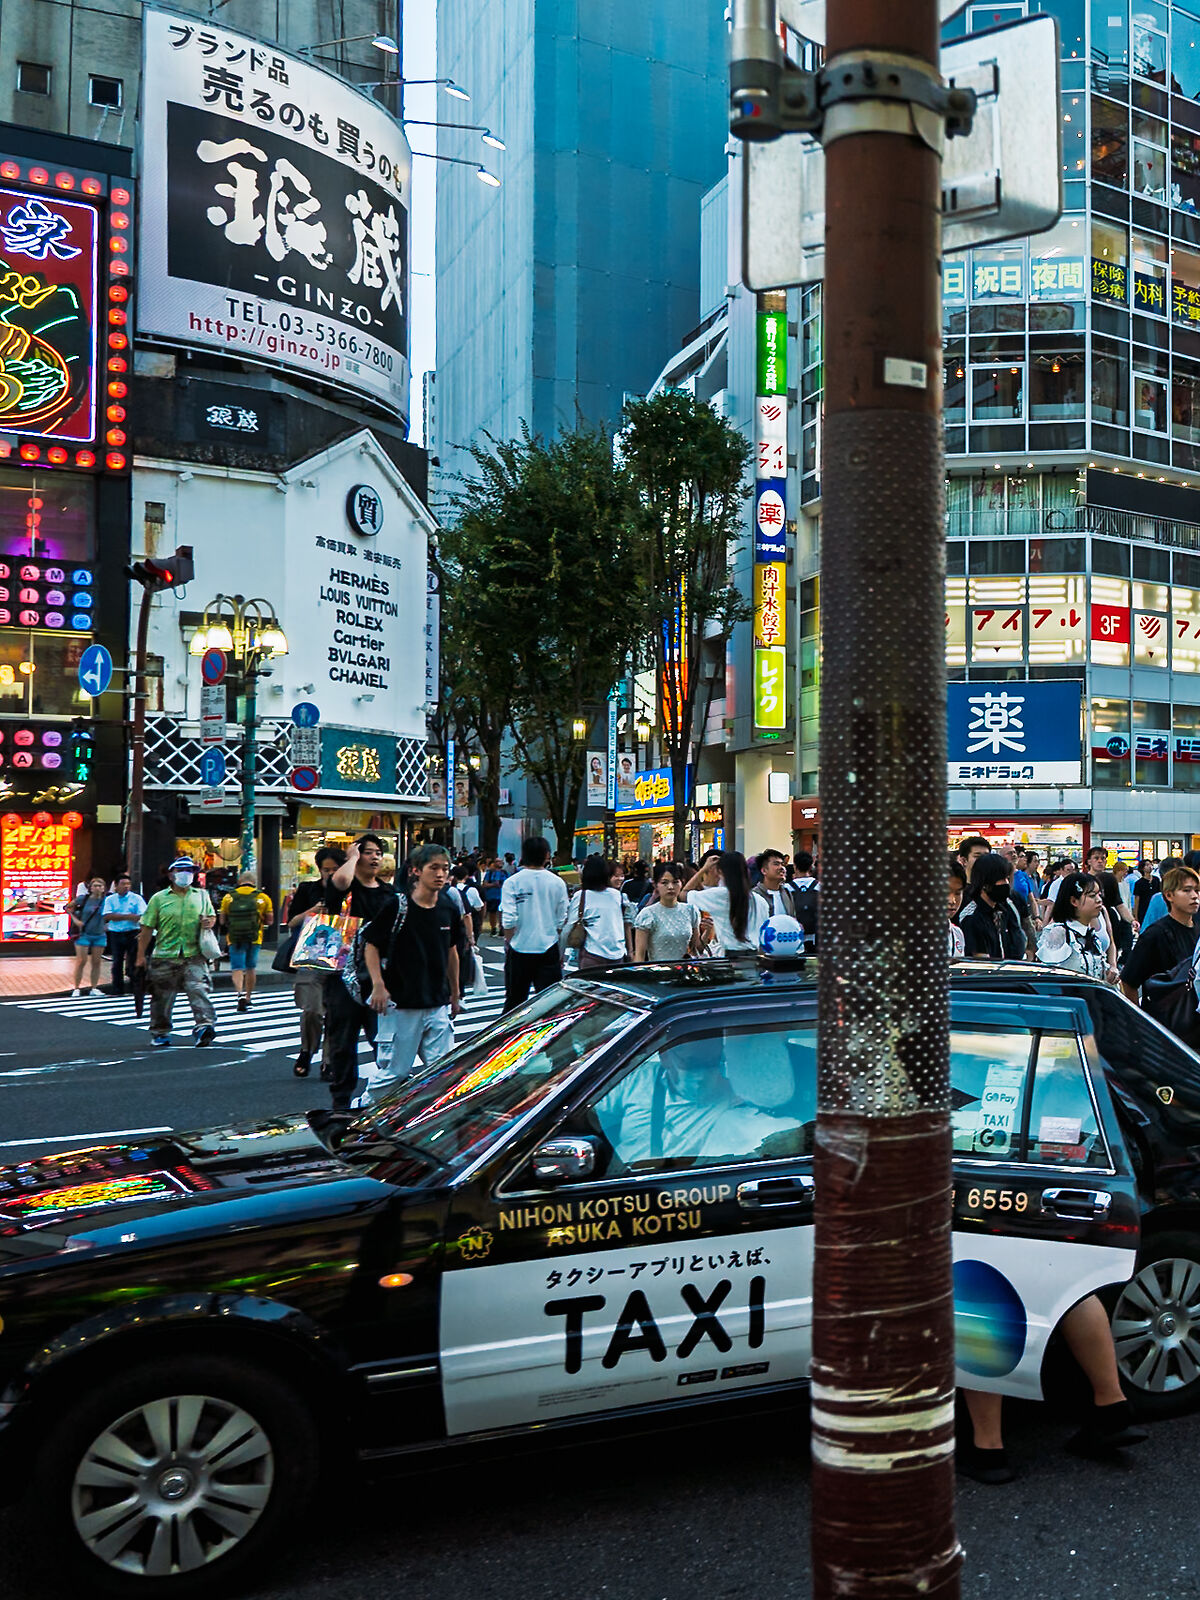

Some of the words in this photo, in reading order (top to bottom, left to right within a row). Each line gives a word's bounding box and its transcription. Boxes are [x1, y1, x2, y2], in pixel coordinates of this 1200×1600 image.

[169, 24, 290, 86] ブランド品
[197, 138, 403, 315] 銀蔵
[945, 268, 964, 292] 日
[975, 266, 1022, 292] 祝日
[1033, 262, 1083, 289] 夜間
[1093, 262, 1125, 283] 保険
[1093, 279, 1125, 300] 診療
[1135, 282, 1164, 307] 内科
[189, 313, 341, 369] http://ginzo.jp
[226, 298, 393, 372] TEL.03-5366-7800
[359, 493, 377, 530] 質
[760, 503, 781, 524] 薬
[315, 535, 357, 556] 高価買取
[329, 568, 390, 595] HERMÈS
[320, 586, 350, 605] LOUIS
[356, 594, 398, 617] VUITTON
[763, 567, 779, 643] 肉汁水餃子
[337, 609, 384, 632] ROLEX
[975, 609, 1081, 631] アイフル
[1100, 616, 1120, 635] 3F
[334, 630, 385, 651] Cartier
[328, 648, 390, 671] BVLGARI
[329, 667, 388, 689] CHANEL
[761, 660, 778, 712] レイク
[966, 692, 1026, 754] 薬
[206, 760, 215, 782] P
[959, 766, 1034, 780] ミネドラッグ
[4, 826, 70, 842] 2F/3F
[985, 1092, 998, 1102] GO
[1000, 1093, 1016, 1104] Pay
[983, 1114, 1009, 1127] TAXI
[499, 1203, 572, 1230] NIHON
[579, 1193, 650, 1219] KOTSU
[657, 1184, 731, 1209] GROUP
[968, 1188, 1028, 1212] 6559
[547, 1220, 621, 1247] ASUKA
[632, 1210, 701, 1237] KOTSU
[469, 1236, 482, 1250] N
[546, 1247, 771, 1289] タクシーアプリといえば、
[544, 1275, 766, 1375] TAXI
